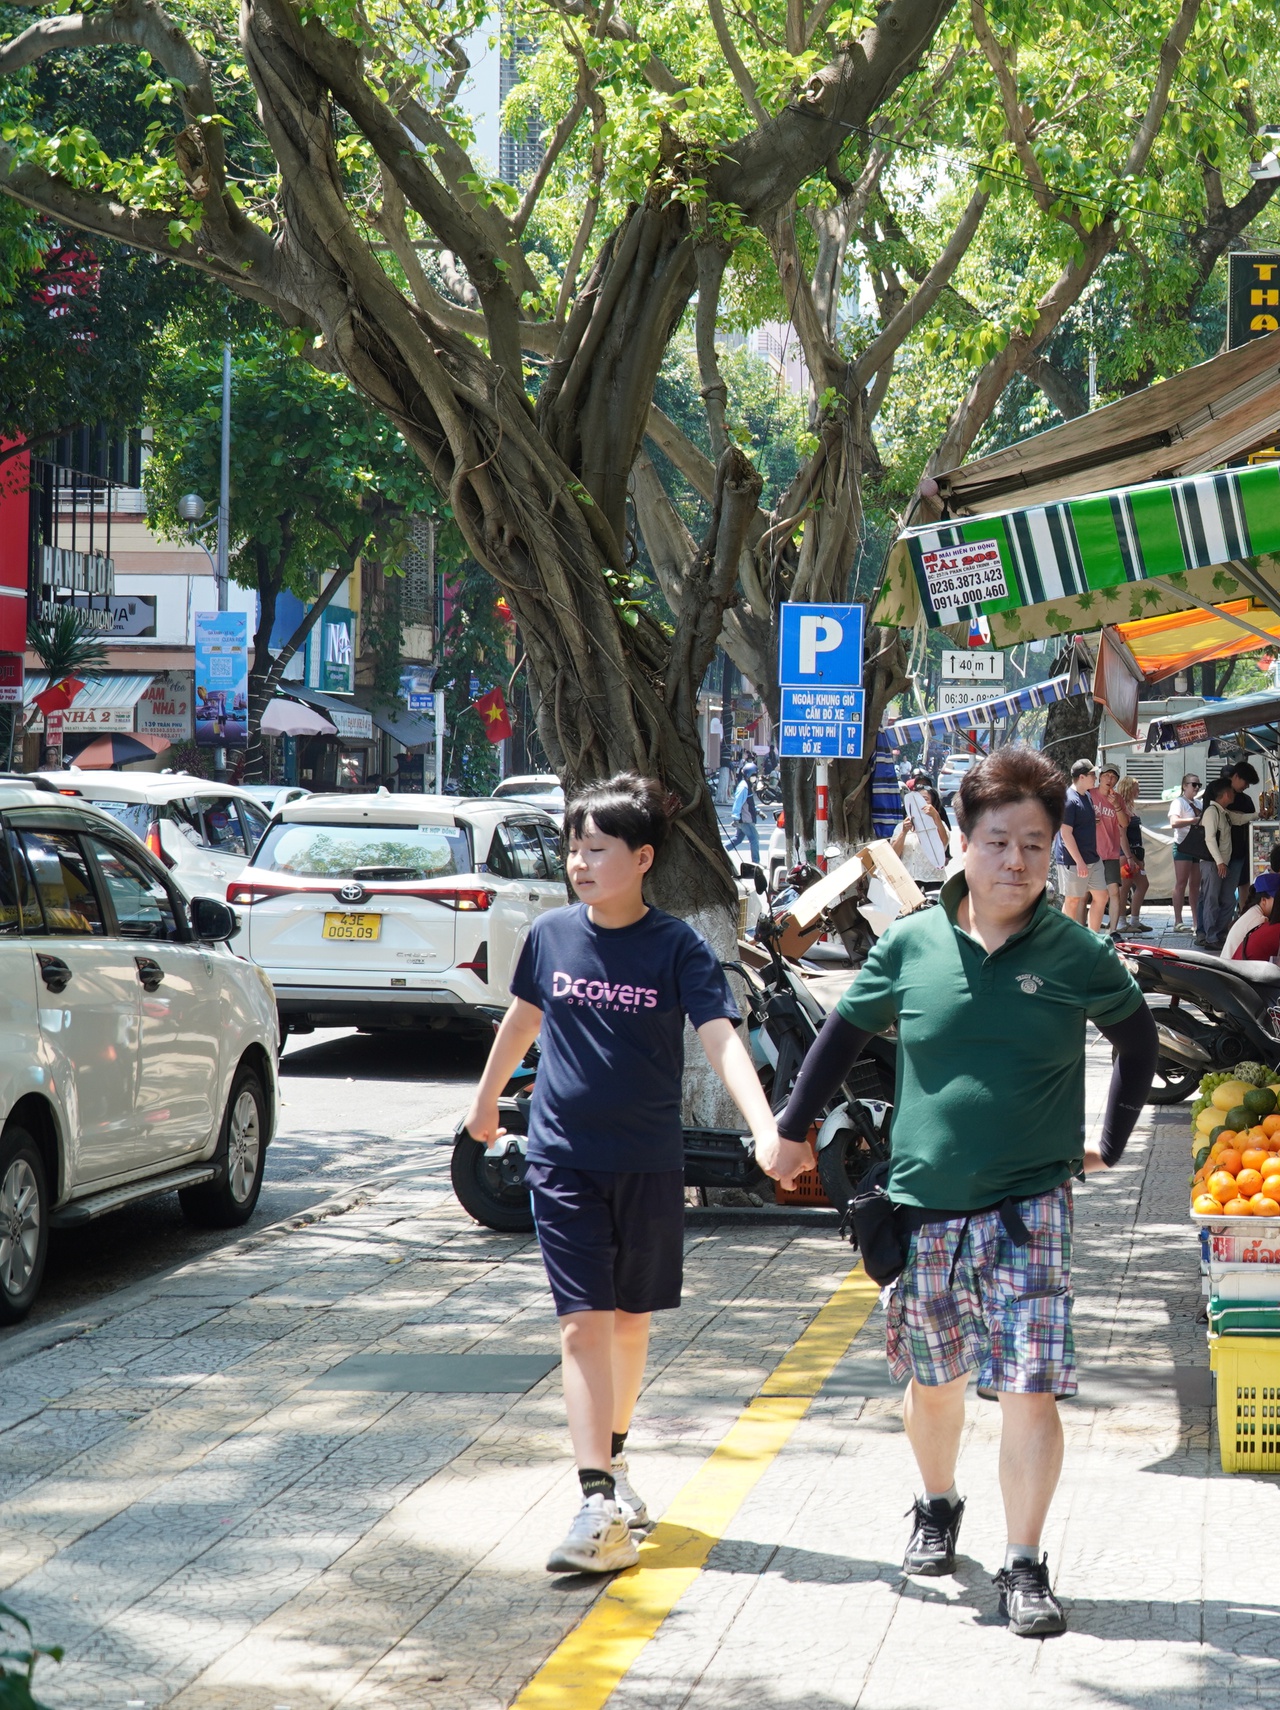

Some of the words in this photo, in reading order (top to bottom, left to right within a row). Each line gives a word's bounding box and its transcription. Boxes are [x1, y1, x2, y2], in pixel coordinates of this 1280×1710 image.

[961, 550, 998, 566] 203
[930, 567, 1003, 595] 0236.3873.423
[933, 583, 1006, 610] 0914.000.460
[799, 615, 844, 674] P
[960, 660, 972, 671] 40
[792, 691, 813, 705] NGOÀI
[816, 694, 840, 706] KHUNG
[842, 692, 855, 706] GIỜ
[945, 693, 969, 704] 06:30
[178, 702, 187, 715] 2
[805, 705, 820, 719] CẤM
[834, 708, 845, 720] XE
[100, 711, 111, 722] 2
[784, 725, 797, 737] KHU
[798, 724, 811, 740] VỰC
[812, 726, 824, 737] THU
[825, 723, 837, 738] PHÍ
[846, 726, 856, 738] TP
[813, 742, 822, 754] XE
[846, 743, 855, 755] 05
[1093, 802, 1115, 818] PARIS
[340, 914, 365, 927] 43E
[328, 926, 373, 939] 005.09
[552, 971, 658, 1008] Dcovers
[567, 997, 638, 1014] ORIGINAL
